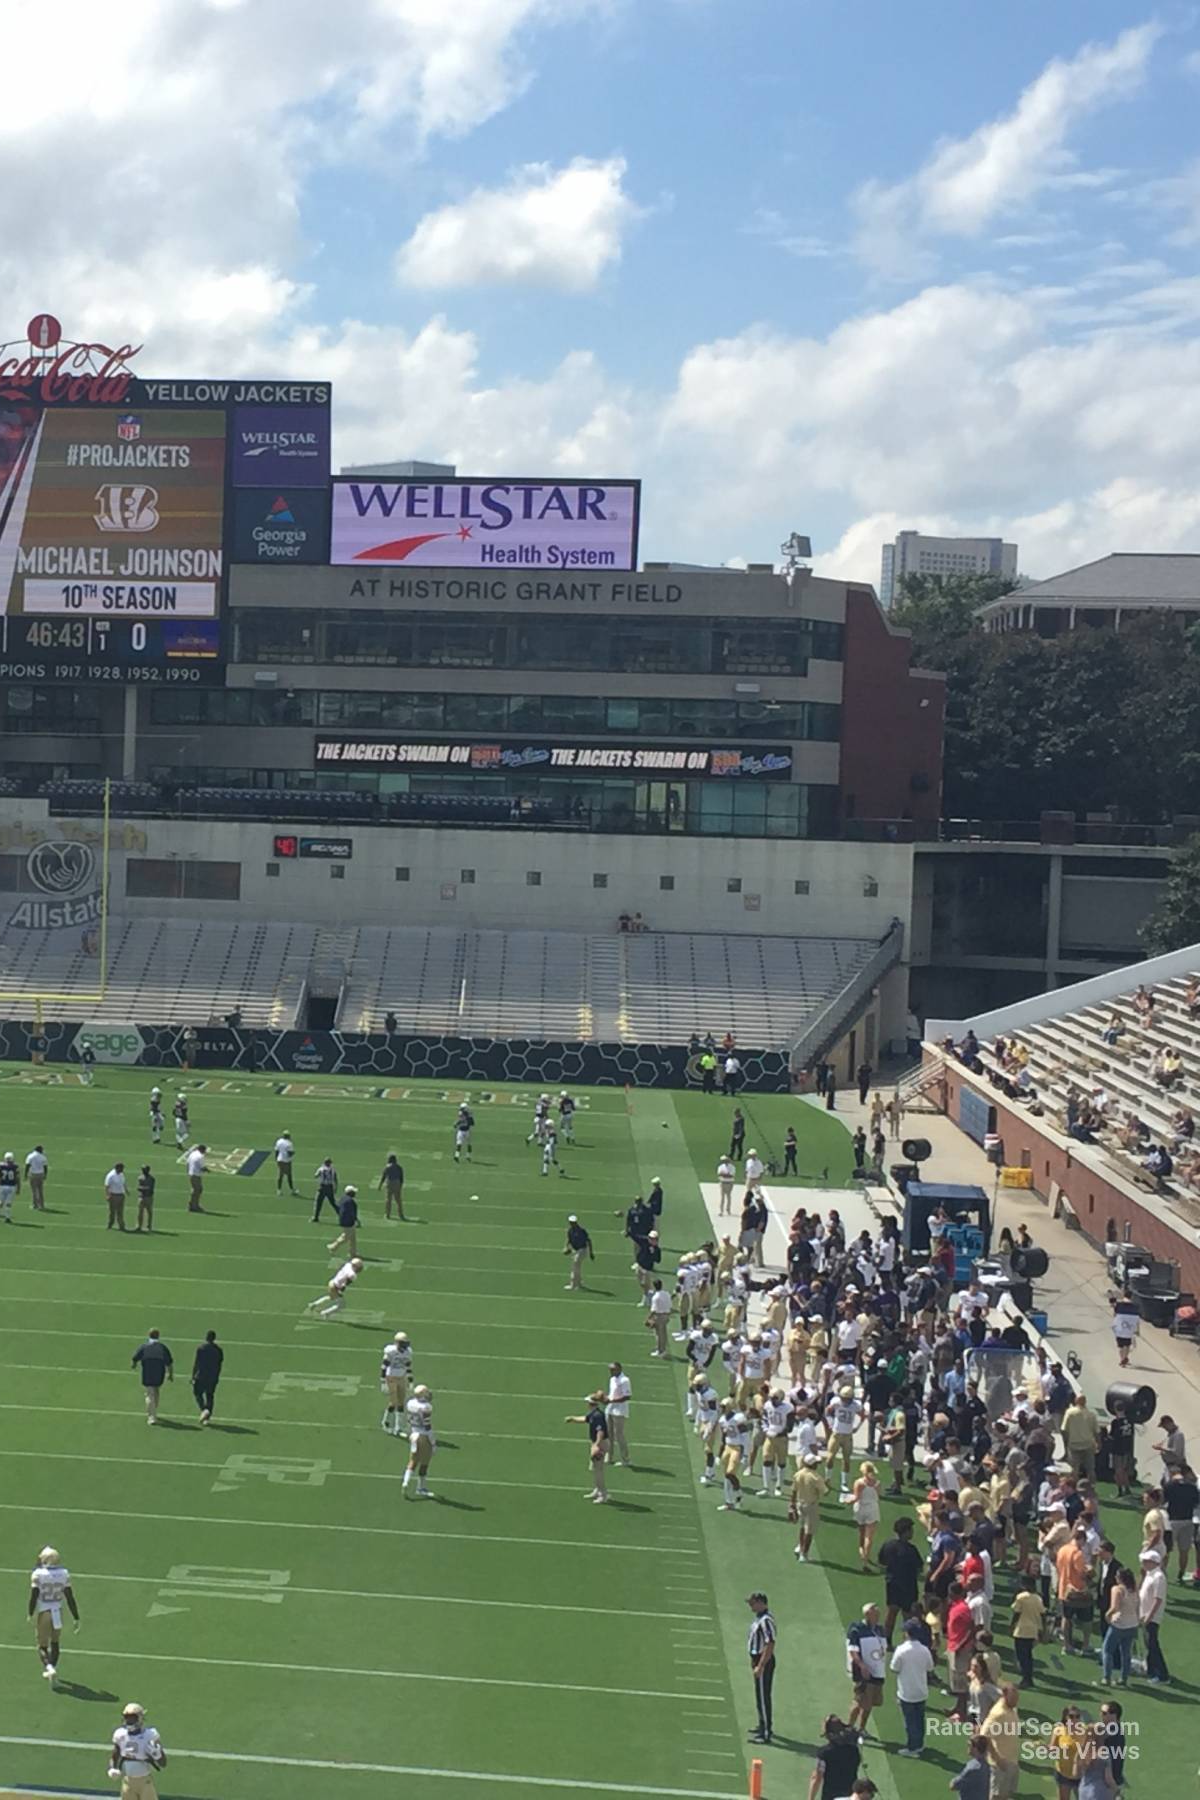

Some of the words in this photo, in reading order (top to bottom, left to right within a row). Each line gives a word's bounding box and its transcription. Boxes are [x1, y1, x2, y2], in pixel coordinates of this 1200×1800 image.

[145, 384, 230, 401] YELLOW
[234, 385, 328, 403] JACKETS
[242, 431, 316, 445] WELLSTAR
[67, 444, 190, 467] #PROJACKETS
[350, 484, 607, 530] WELLSTAR
[252, 527, 307, 544] Georgia
[258, 542, 300, 557] Power
[481, 543, 543, 565] Health
[547, 545, 615, 570] System
[16, 546, 114, 575] MICHAEL
[120, 548, 222, 578] JOHNSON
[61, 583, 97, 609] 10TH
[102, 585, 177, 610] SEASON
[350, 579, 381, 597] AT
[389, 580, 507, 600] HISTORIC
[516, 582, 602, 602] GRANT
[611, 584, 682, 603] FIELD
[26, 621, 84, 647] 46:43
[132, 622, 147, 651] 0
[166, 668, 200, 681] 1990
[316, 743, 342, 760] THE
[341, 743, 396, 761] JACKETS
[396, 745, 449, 762] SWARM
[450, 746, 471, 763] ON
[550, 749, 576, 765] THE
[575, 749, 632, 767] JACKETS
[633, 751, 687, 768] SWARM
[687, 752, 709, 769] ON
[81, 1031, 139, 1057] sage
